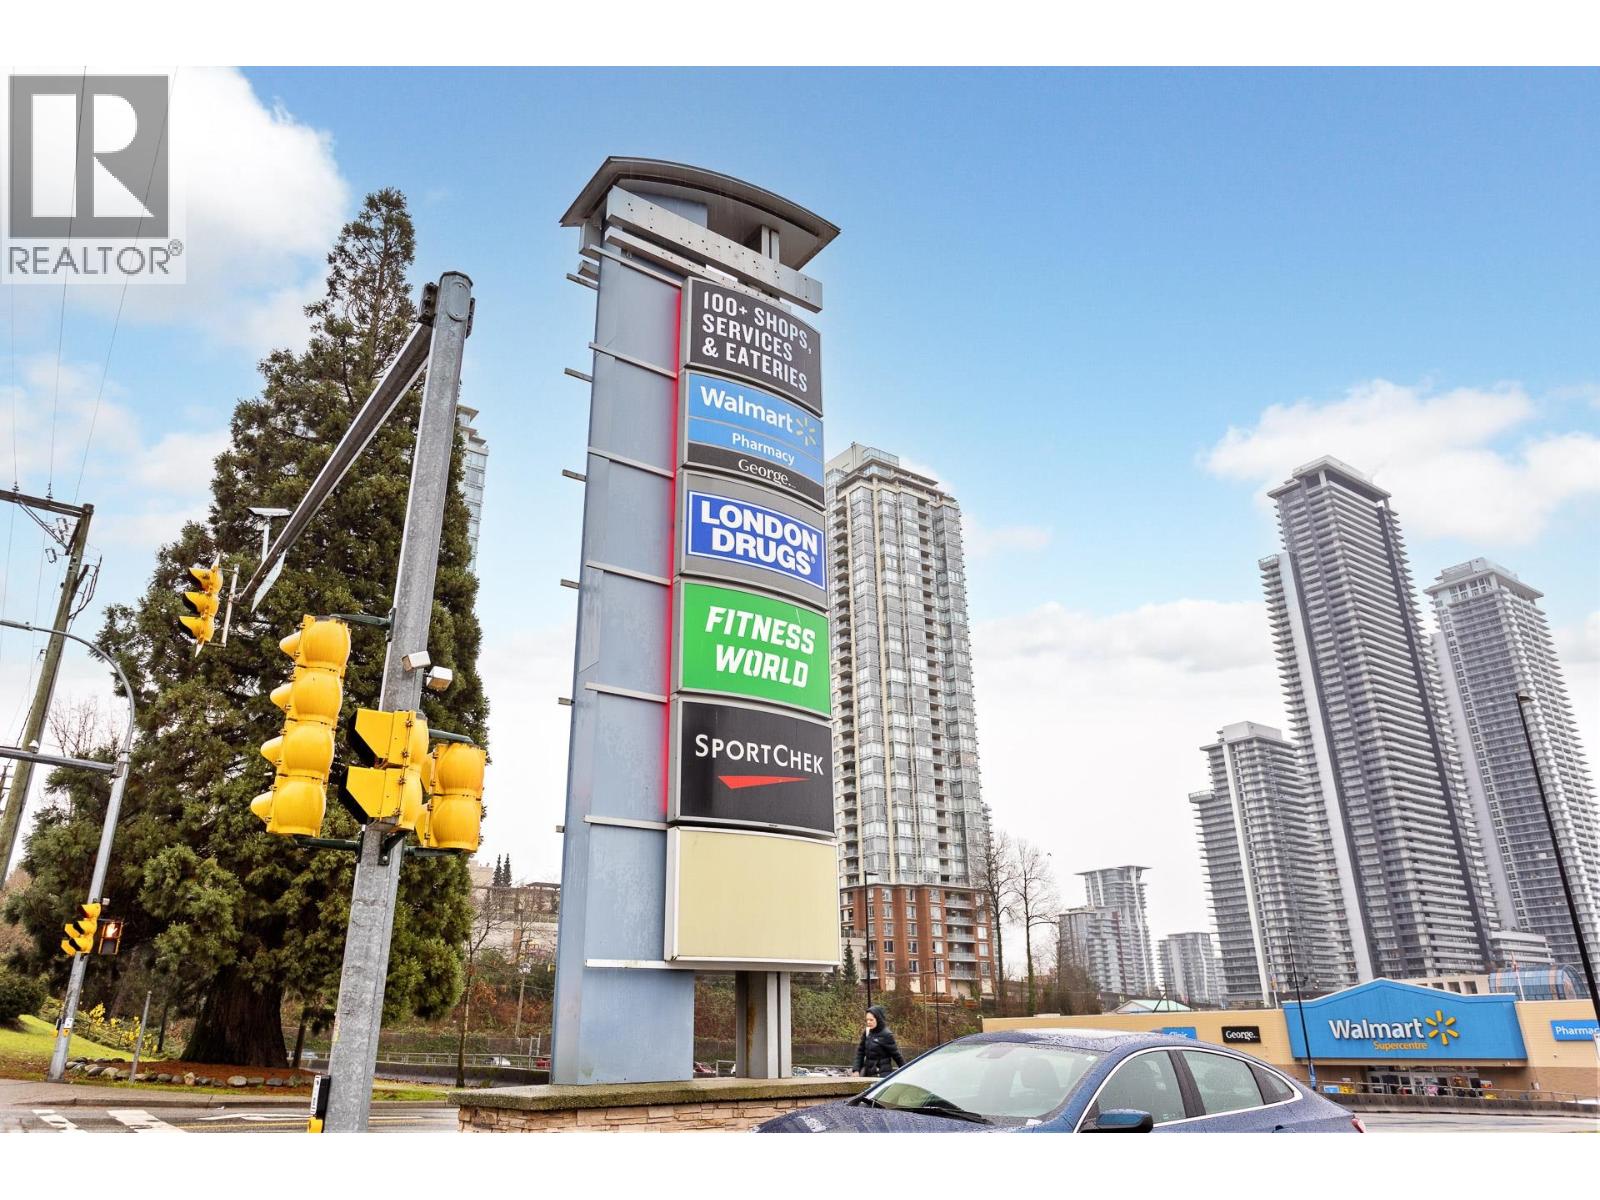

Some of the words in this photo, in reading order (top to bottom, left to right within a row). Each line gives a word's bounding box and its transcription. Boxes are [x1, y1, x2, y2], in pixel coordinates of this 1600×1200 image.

[702, 313, 793, 362] SERVICES
[703, 290, 748, 317] 100+
[754, 307, 813, 355] SHOPS,
[702, 337, 719, 359] &
[725, 342, 808, 393] EATERIES
[700, 385, 793, 434] Walmart
[732, 432, 795, 466] Pharmacy
[701, 499, 818, 556] LONDON
[704, 605, 816, 656] FITNESS
[715, 643, 809, 689] WORLD
[1328, 1018, 1425, 1040] Walmart
[1372, 1040, 1429, 1051] Supercentre
